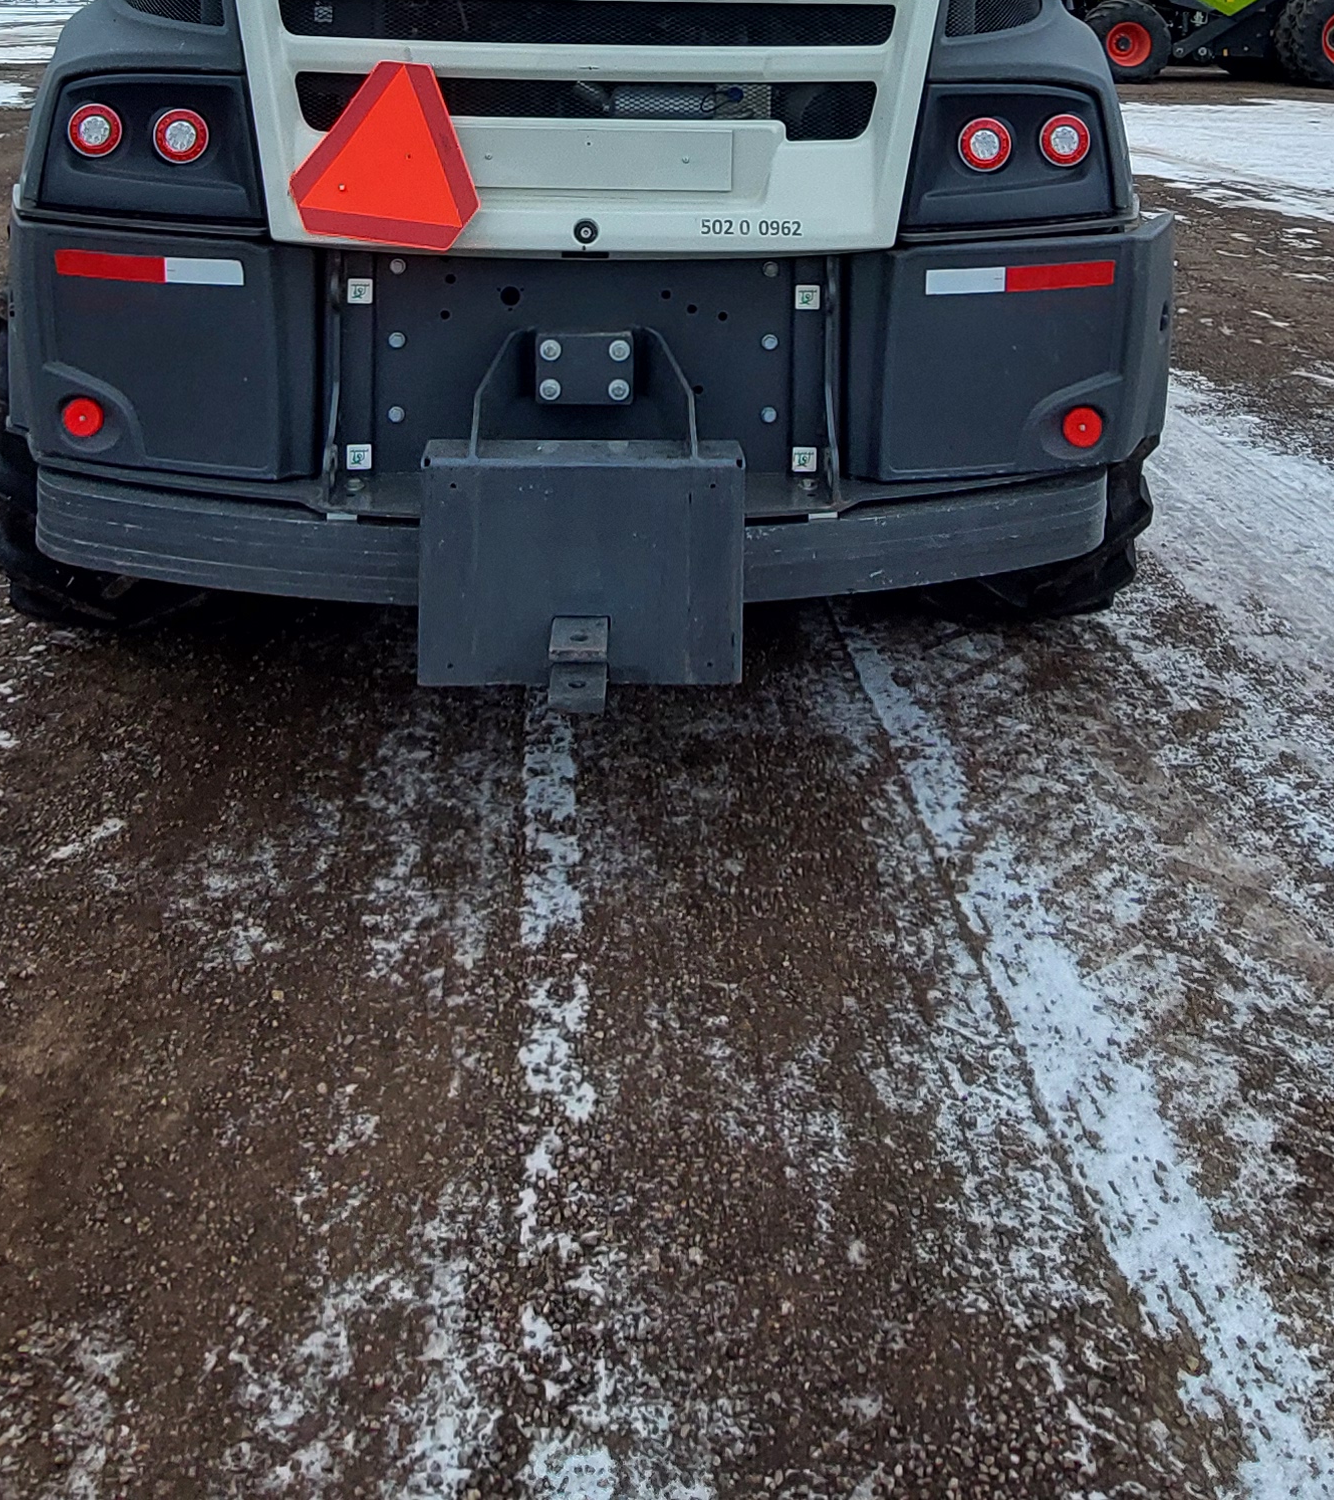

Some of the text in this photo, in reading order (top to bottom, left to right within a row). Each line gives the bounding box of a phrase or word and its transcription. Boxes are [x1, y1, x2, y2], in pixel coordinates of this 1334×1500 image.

[701, 218, 802, 237] 502 0 0962
